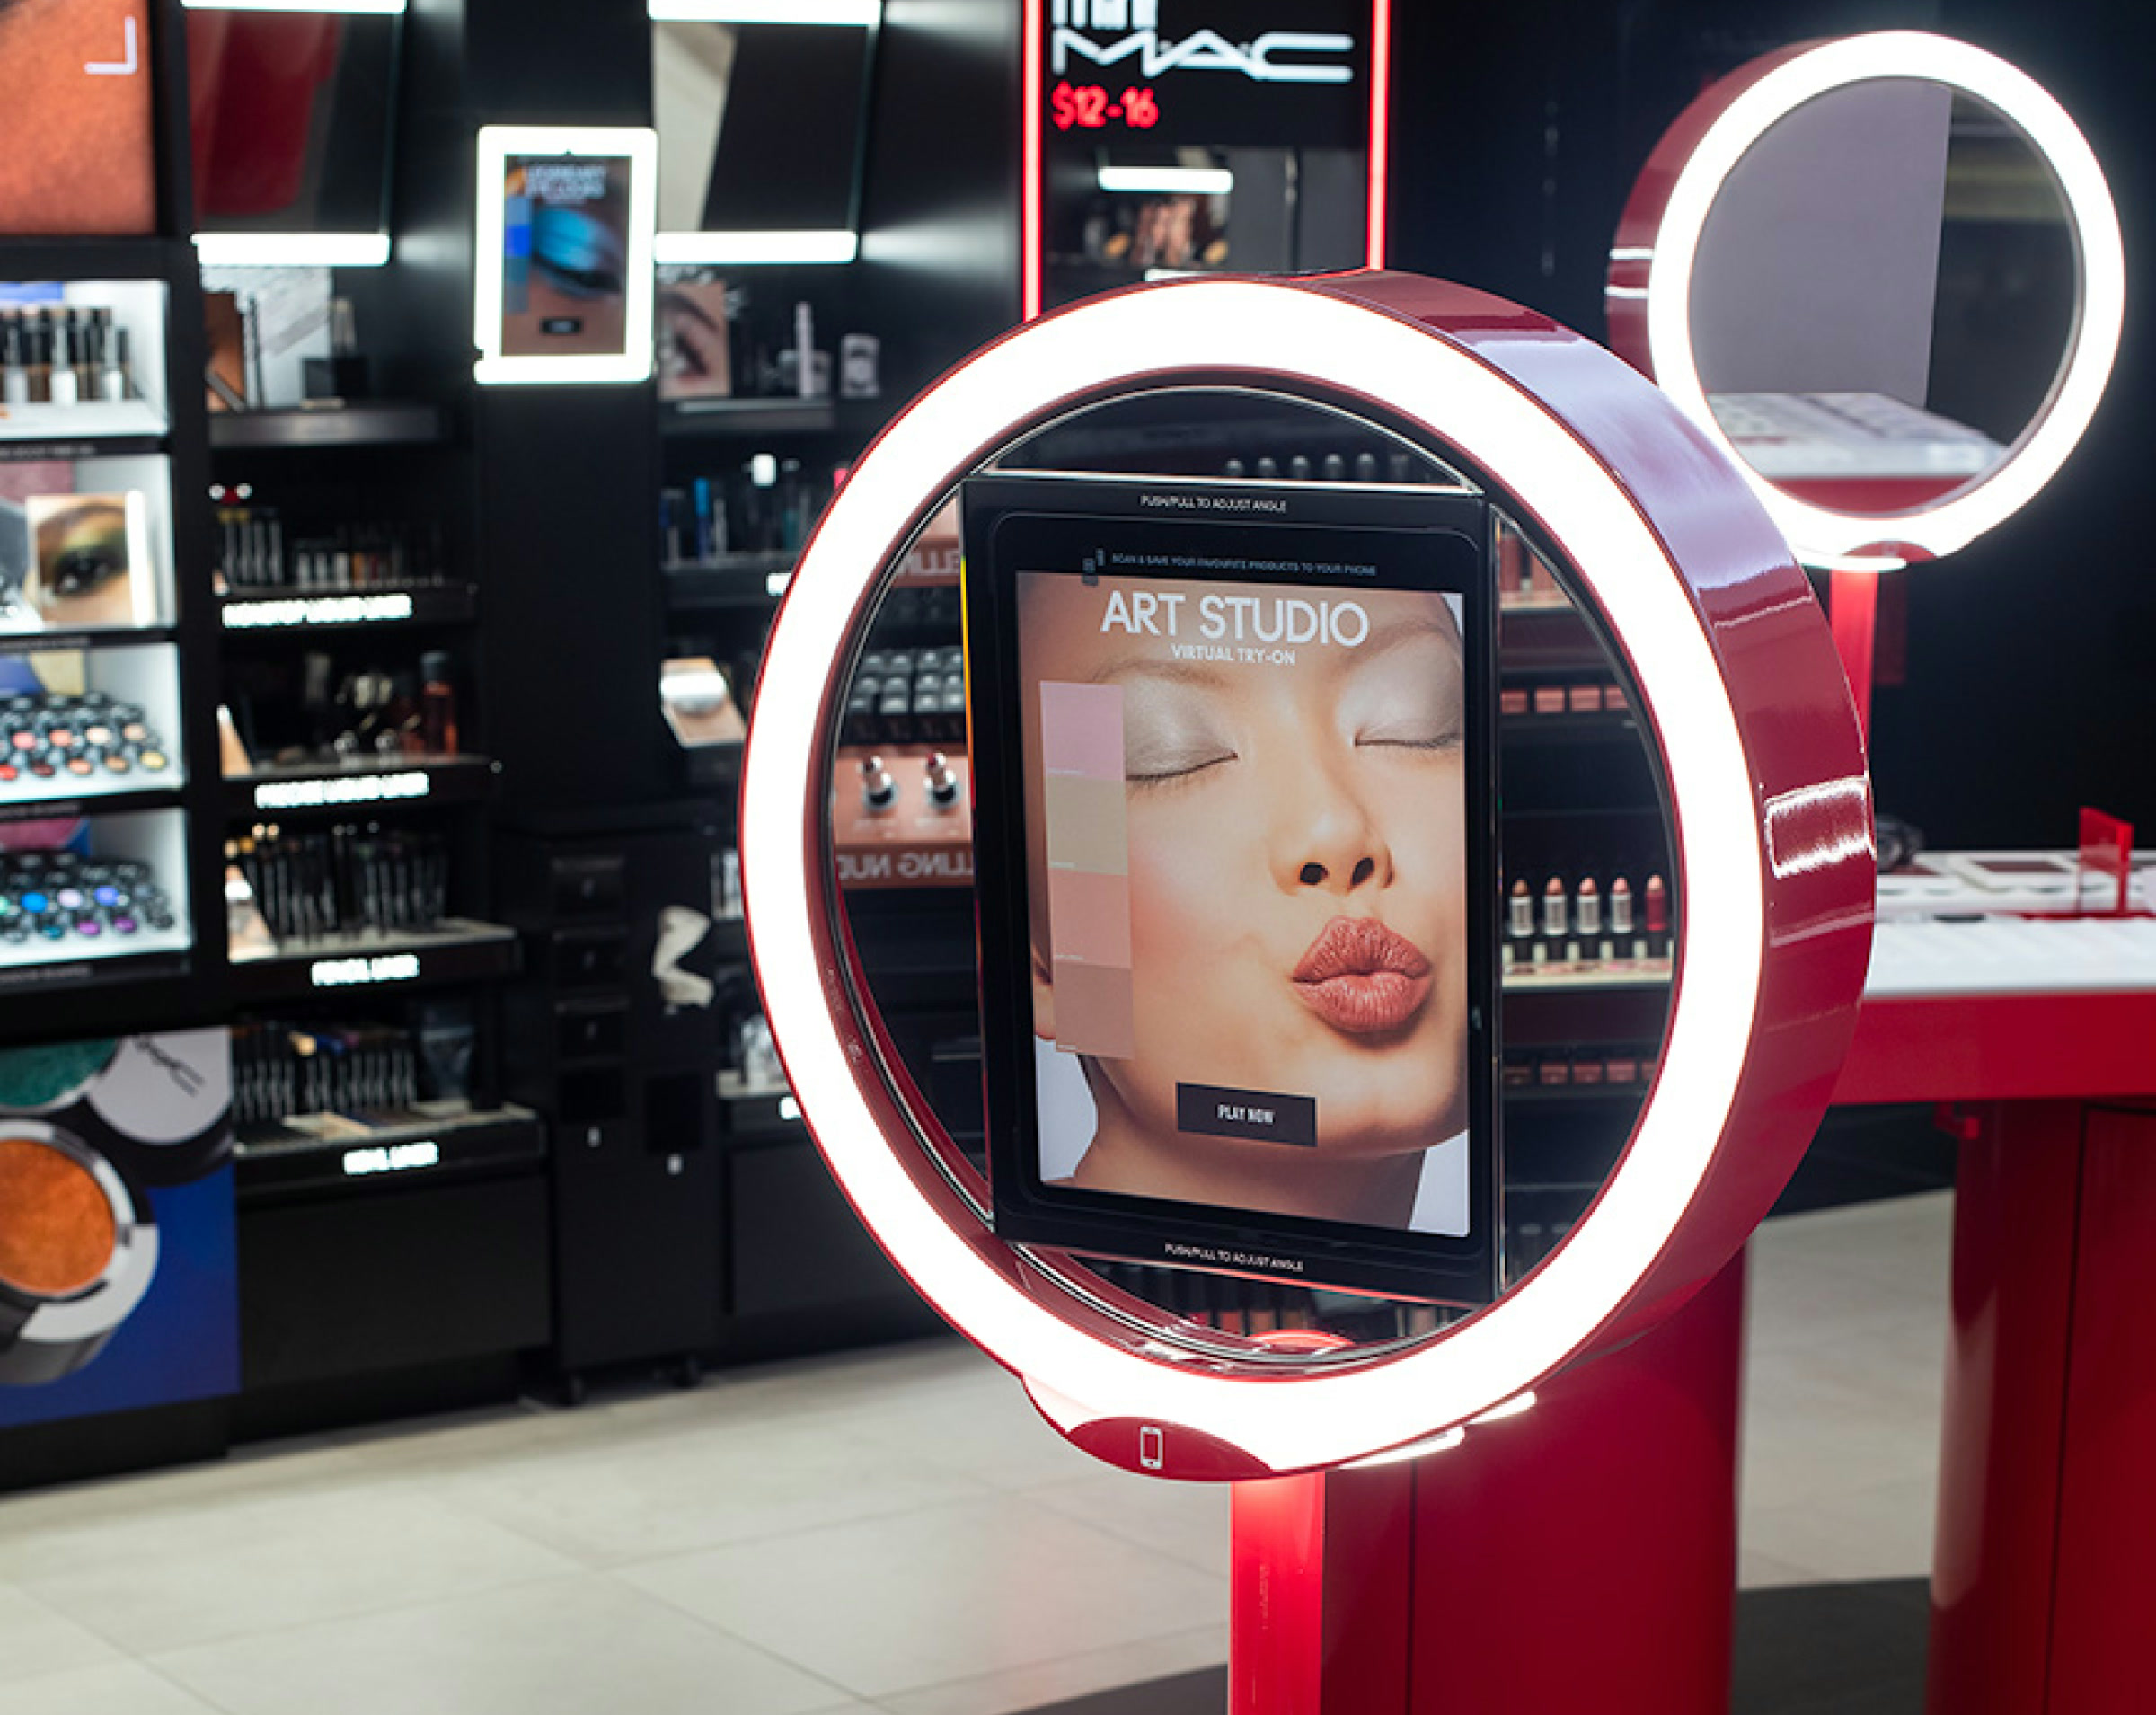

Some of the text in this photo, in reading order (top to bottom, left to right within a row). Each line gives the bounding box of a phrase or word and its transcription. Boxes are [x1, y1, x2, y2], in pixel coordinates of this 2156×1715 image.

[1051, 80, 1159, 130] $12-16
[1140, 495, 1286, 513] PUSH/PULL TO ADJUST ANGLE
[1147, 554, 1169, 566] SAVE
[1171, 556, 1197, 568] YOUR
[1250, 560, 1299, 571] PRODUCTS
[1301, 562, 1313, 574] TO
[1315, 562, 1340, 574] YOUR
[1344, 564, 1377, 577] PHONE
[1100, 589, 1370, 648] ART STUDIO
[1170, 643, 1296, 666] VIRTUAL TRY-ON
[1217, 1103, 1275, 1126] PLAY NOW
[1165, 1243, 1303, 1272] PUSH/PULL TO ADJUST ANGLE
